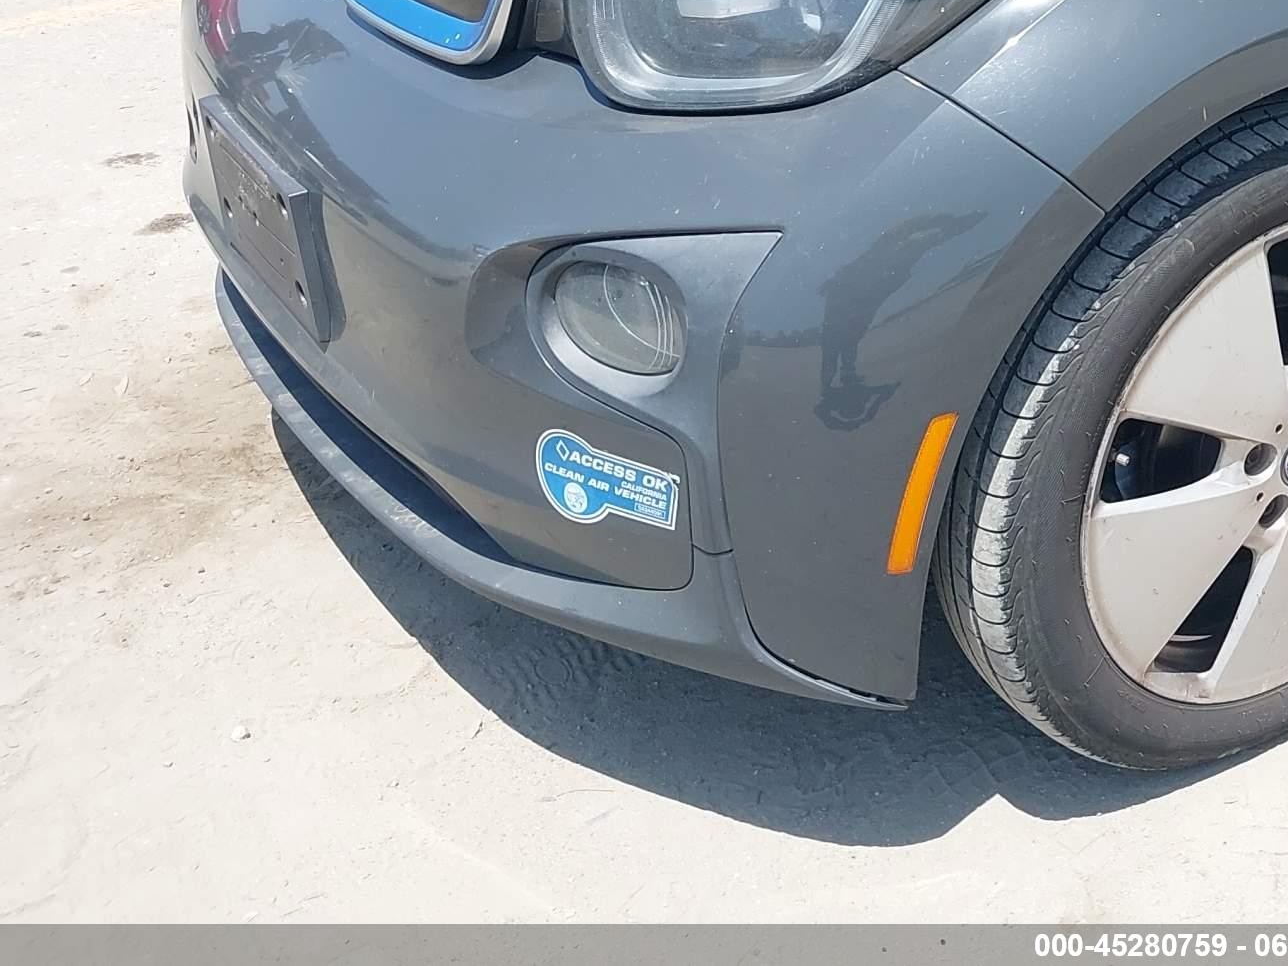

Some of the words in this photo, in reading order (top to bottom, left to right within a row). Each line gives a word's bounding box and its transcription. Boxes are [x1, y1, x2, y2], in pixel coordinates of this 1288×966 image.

[544, 462, 585, 483] CLEAN
[587, 478, 610, 492] AIR
[614, 485, 667, 509] VEHICLE
[569, 450, 637, 482] ACCESS
[642, 474, 669, 492] OK
[621, 480, 667, 501] CALIFORNIA
